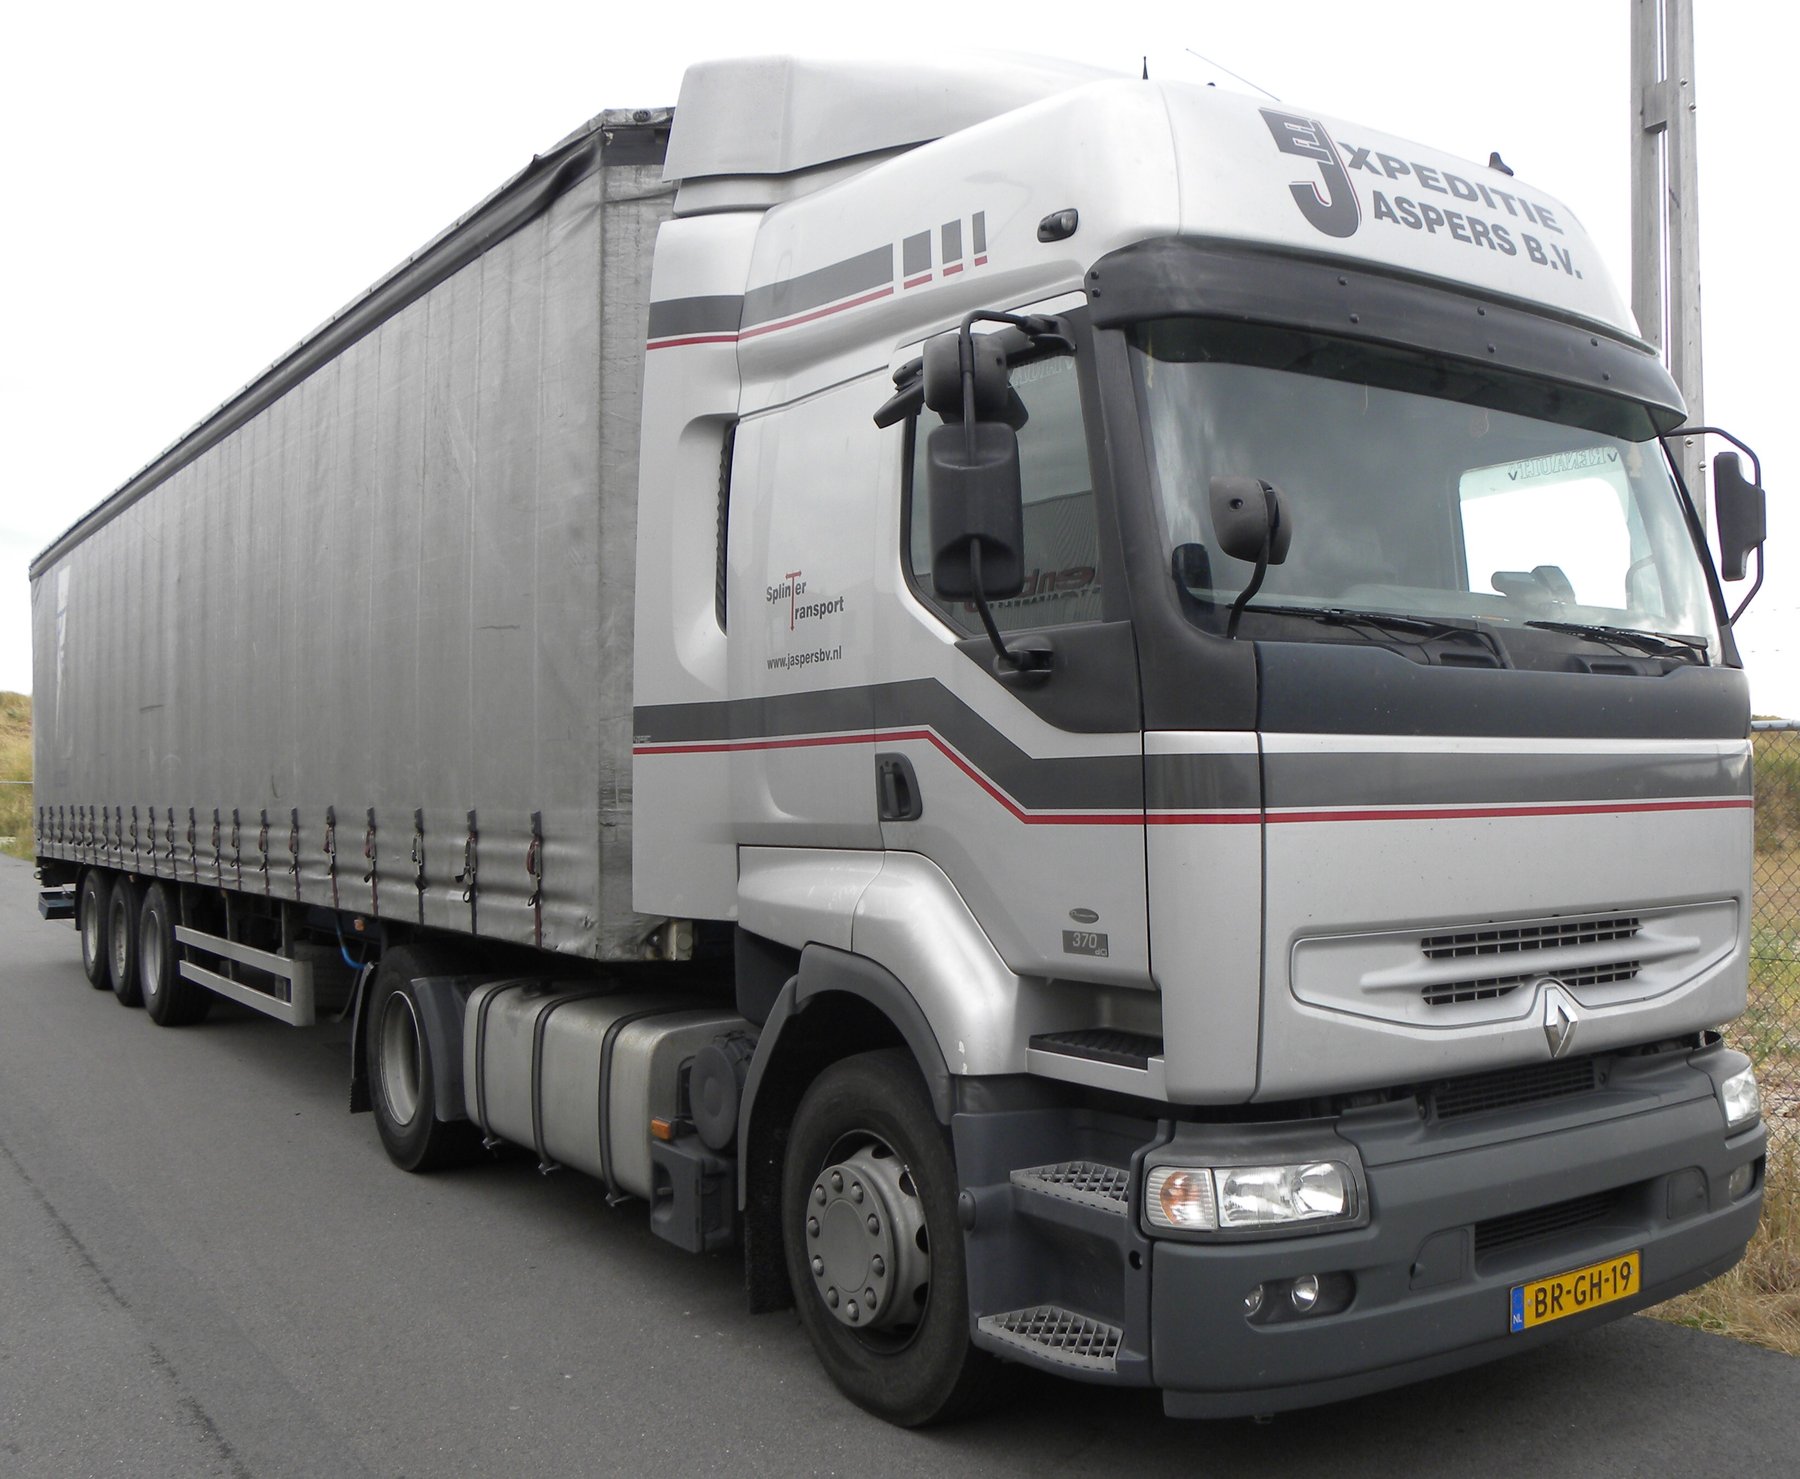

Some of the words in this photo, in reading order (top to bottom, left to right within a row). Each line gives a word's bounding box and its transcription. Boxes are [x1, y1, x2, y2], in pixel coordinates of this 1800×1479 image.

[1521, 232, 1584, 280] B.V.
[767, 645, 842, 670] www.jaspersbv.nl
[1072, 932, 1097, 948] 370
[1534, 1261, 1632, 1319] BR-GH-19
[1513, 1313, 1522, 1324] NL
